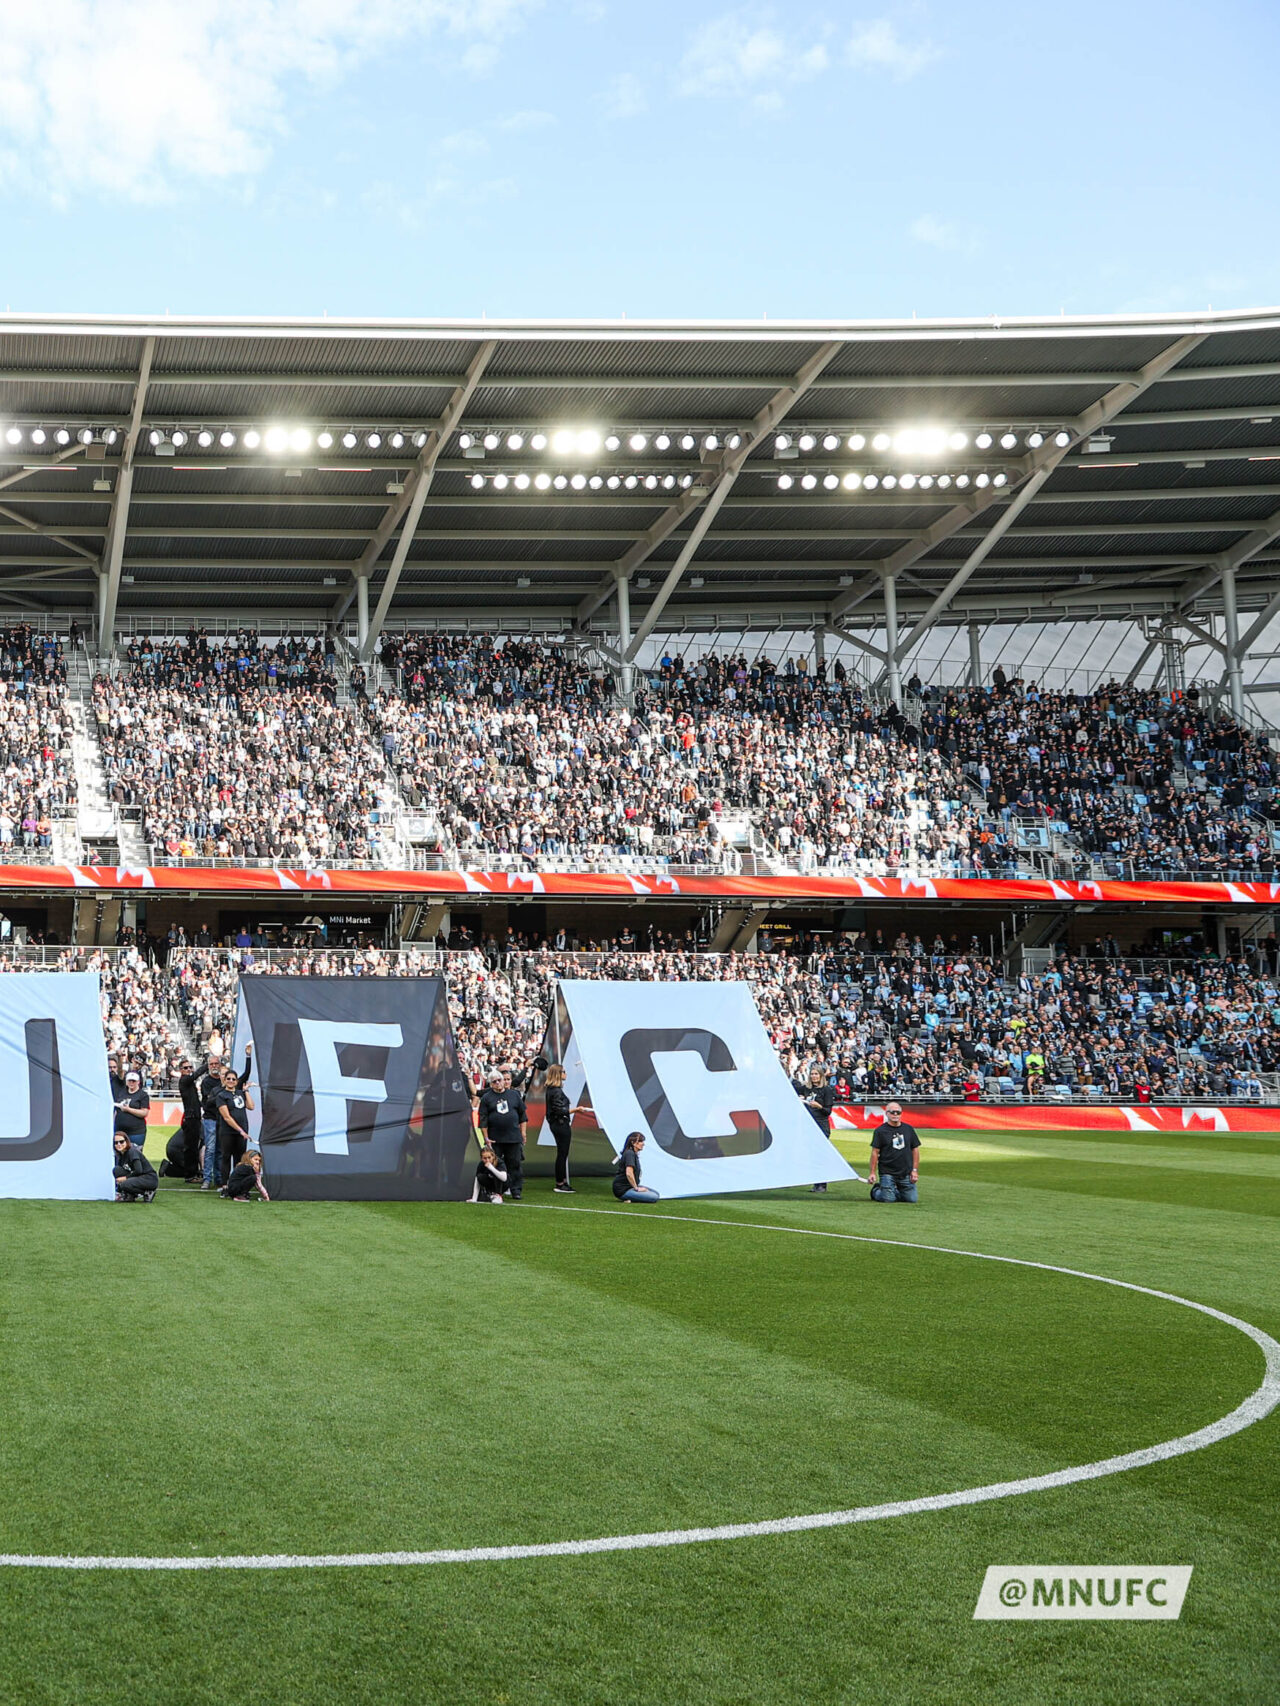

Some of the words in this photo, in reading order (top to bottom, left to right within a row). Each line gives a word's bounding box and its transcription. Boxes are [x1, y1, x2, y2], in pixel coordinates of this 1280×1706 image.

[346, 916, 371, 924] Market
[297, 1018, 404, 1156] F
[619, 1028, 773, 1160] C
